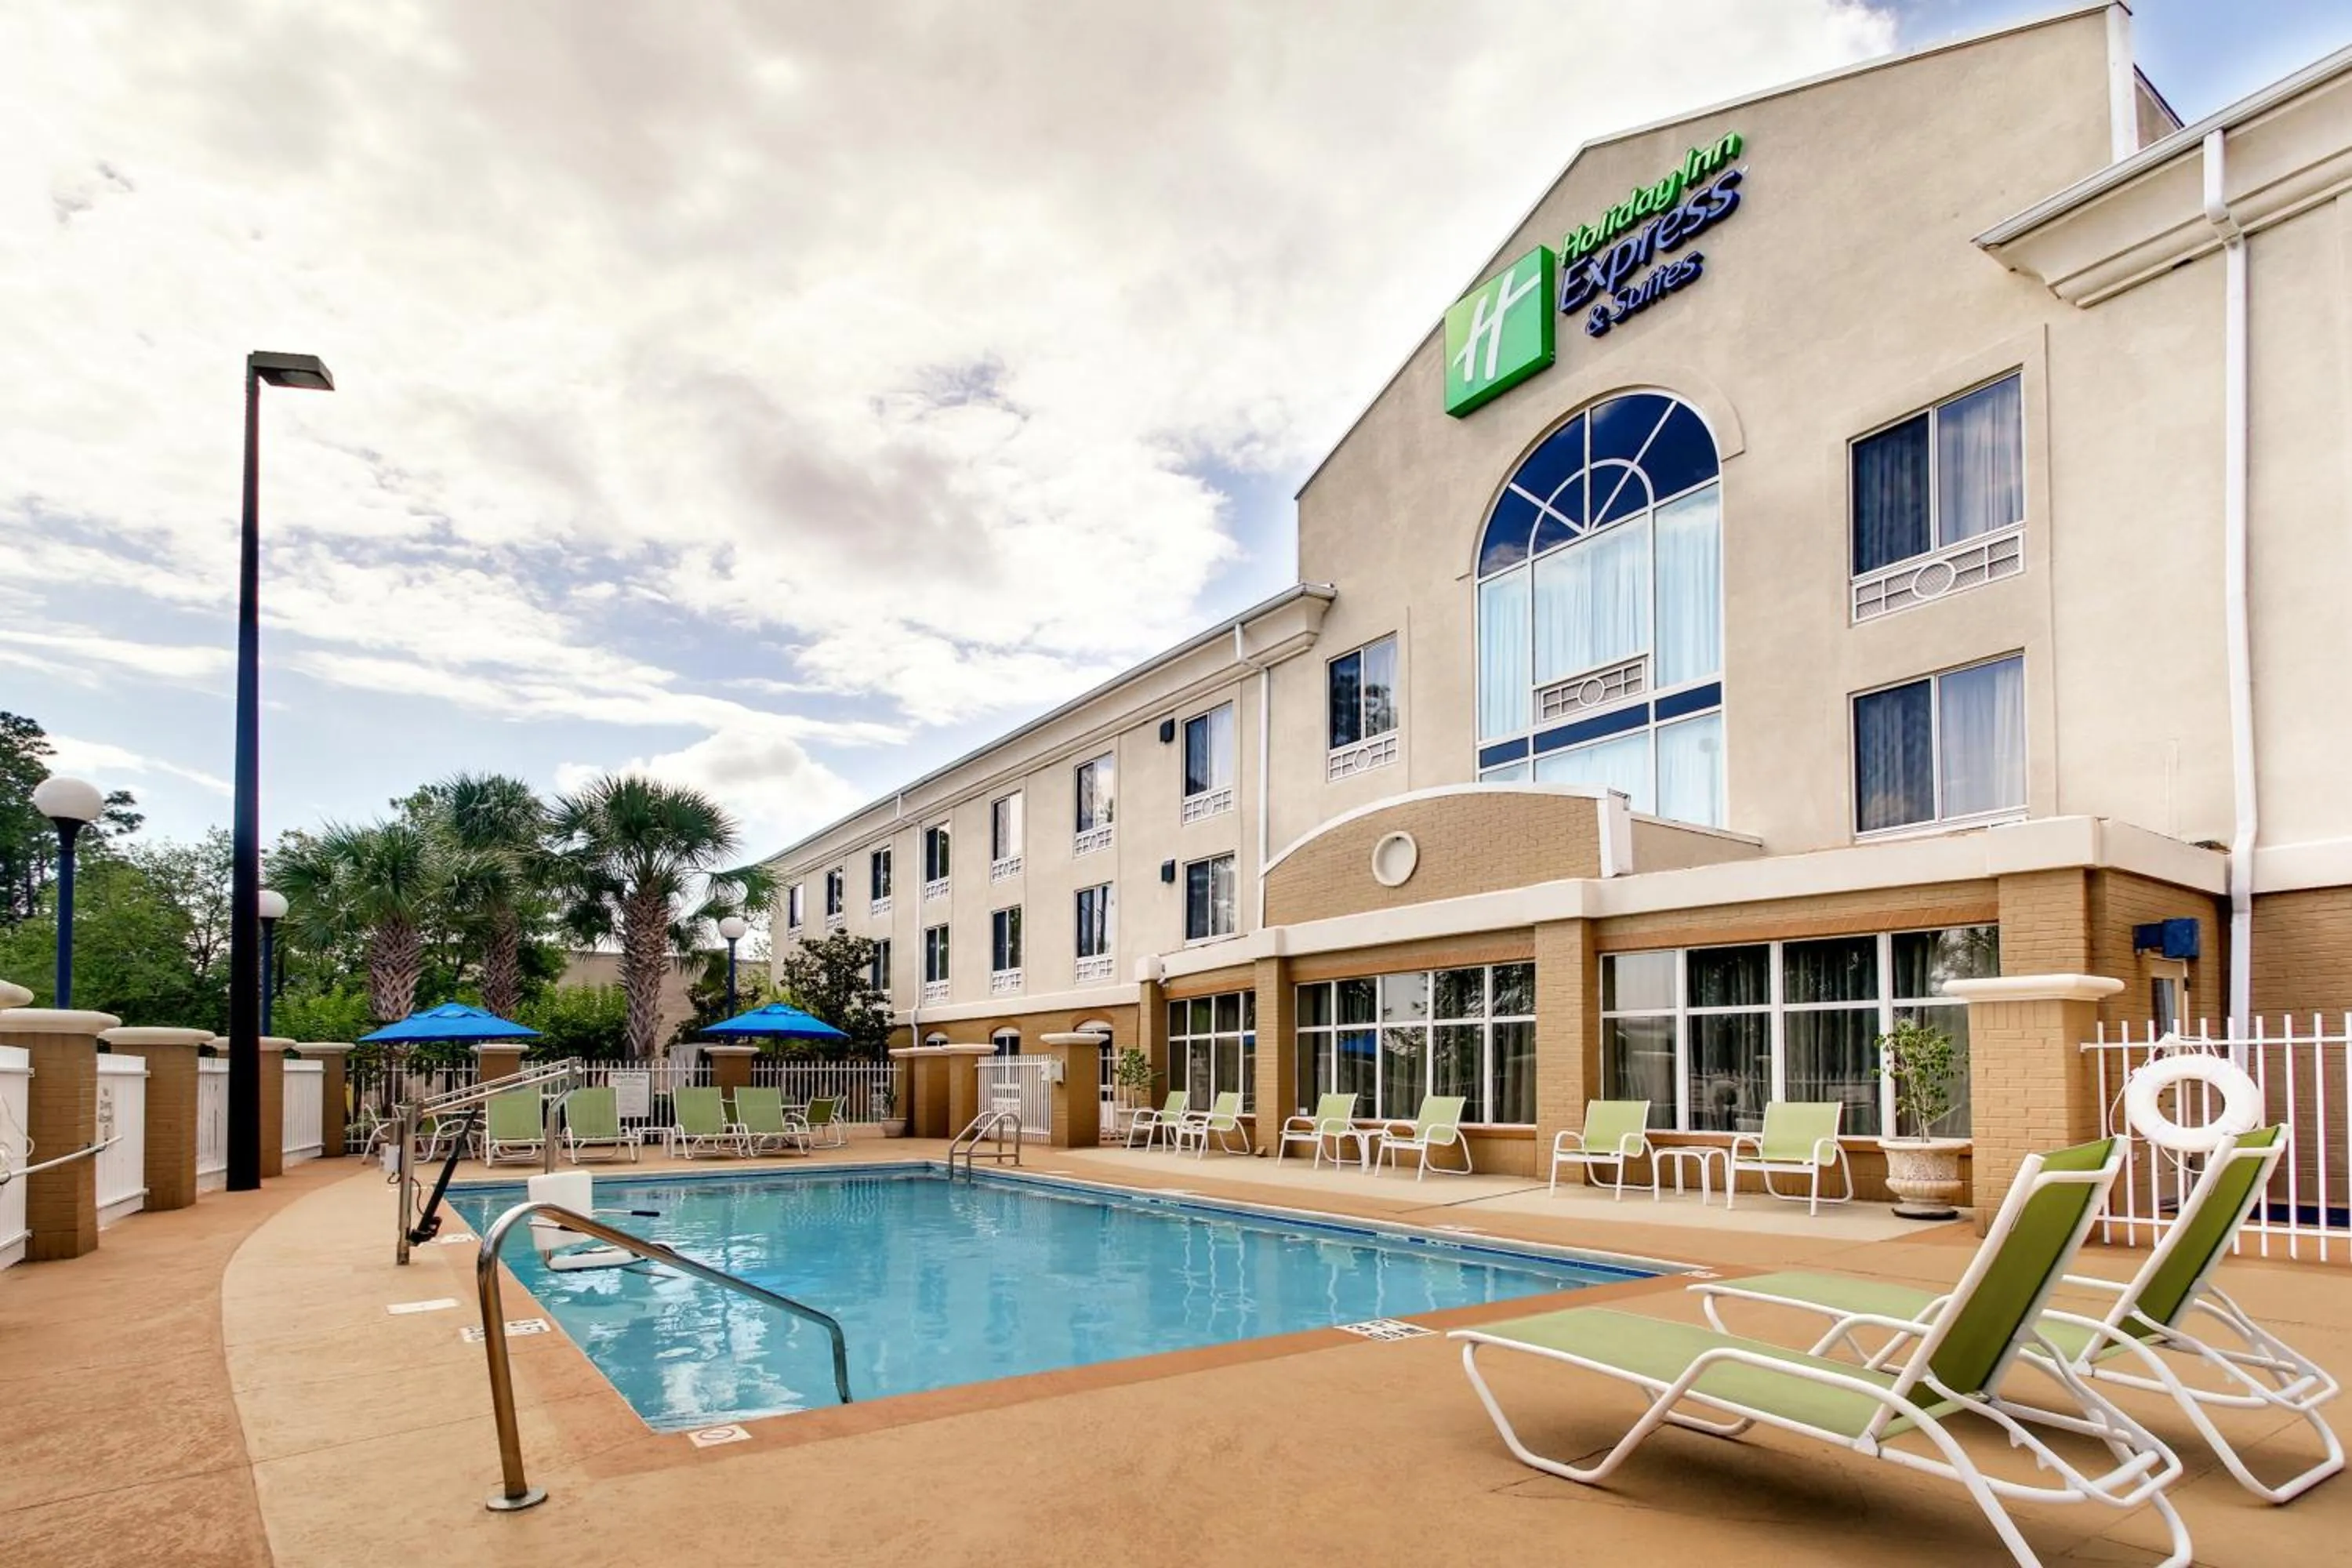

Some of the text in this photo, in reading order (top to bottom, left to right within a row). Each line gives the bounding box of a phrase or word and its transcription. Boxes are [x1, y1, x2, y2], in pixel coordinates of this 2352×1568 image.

[1558, 131, 1743, 266] Holiday Inn
[1558, 169, 1743, 314] Express
[1585, 250, 1704, 337] & Suites
